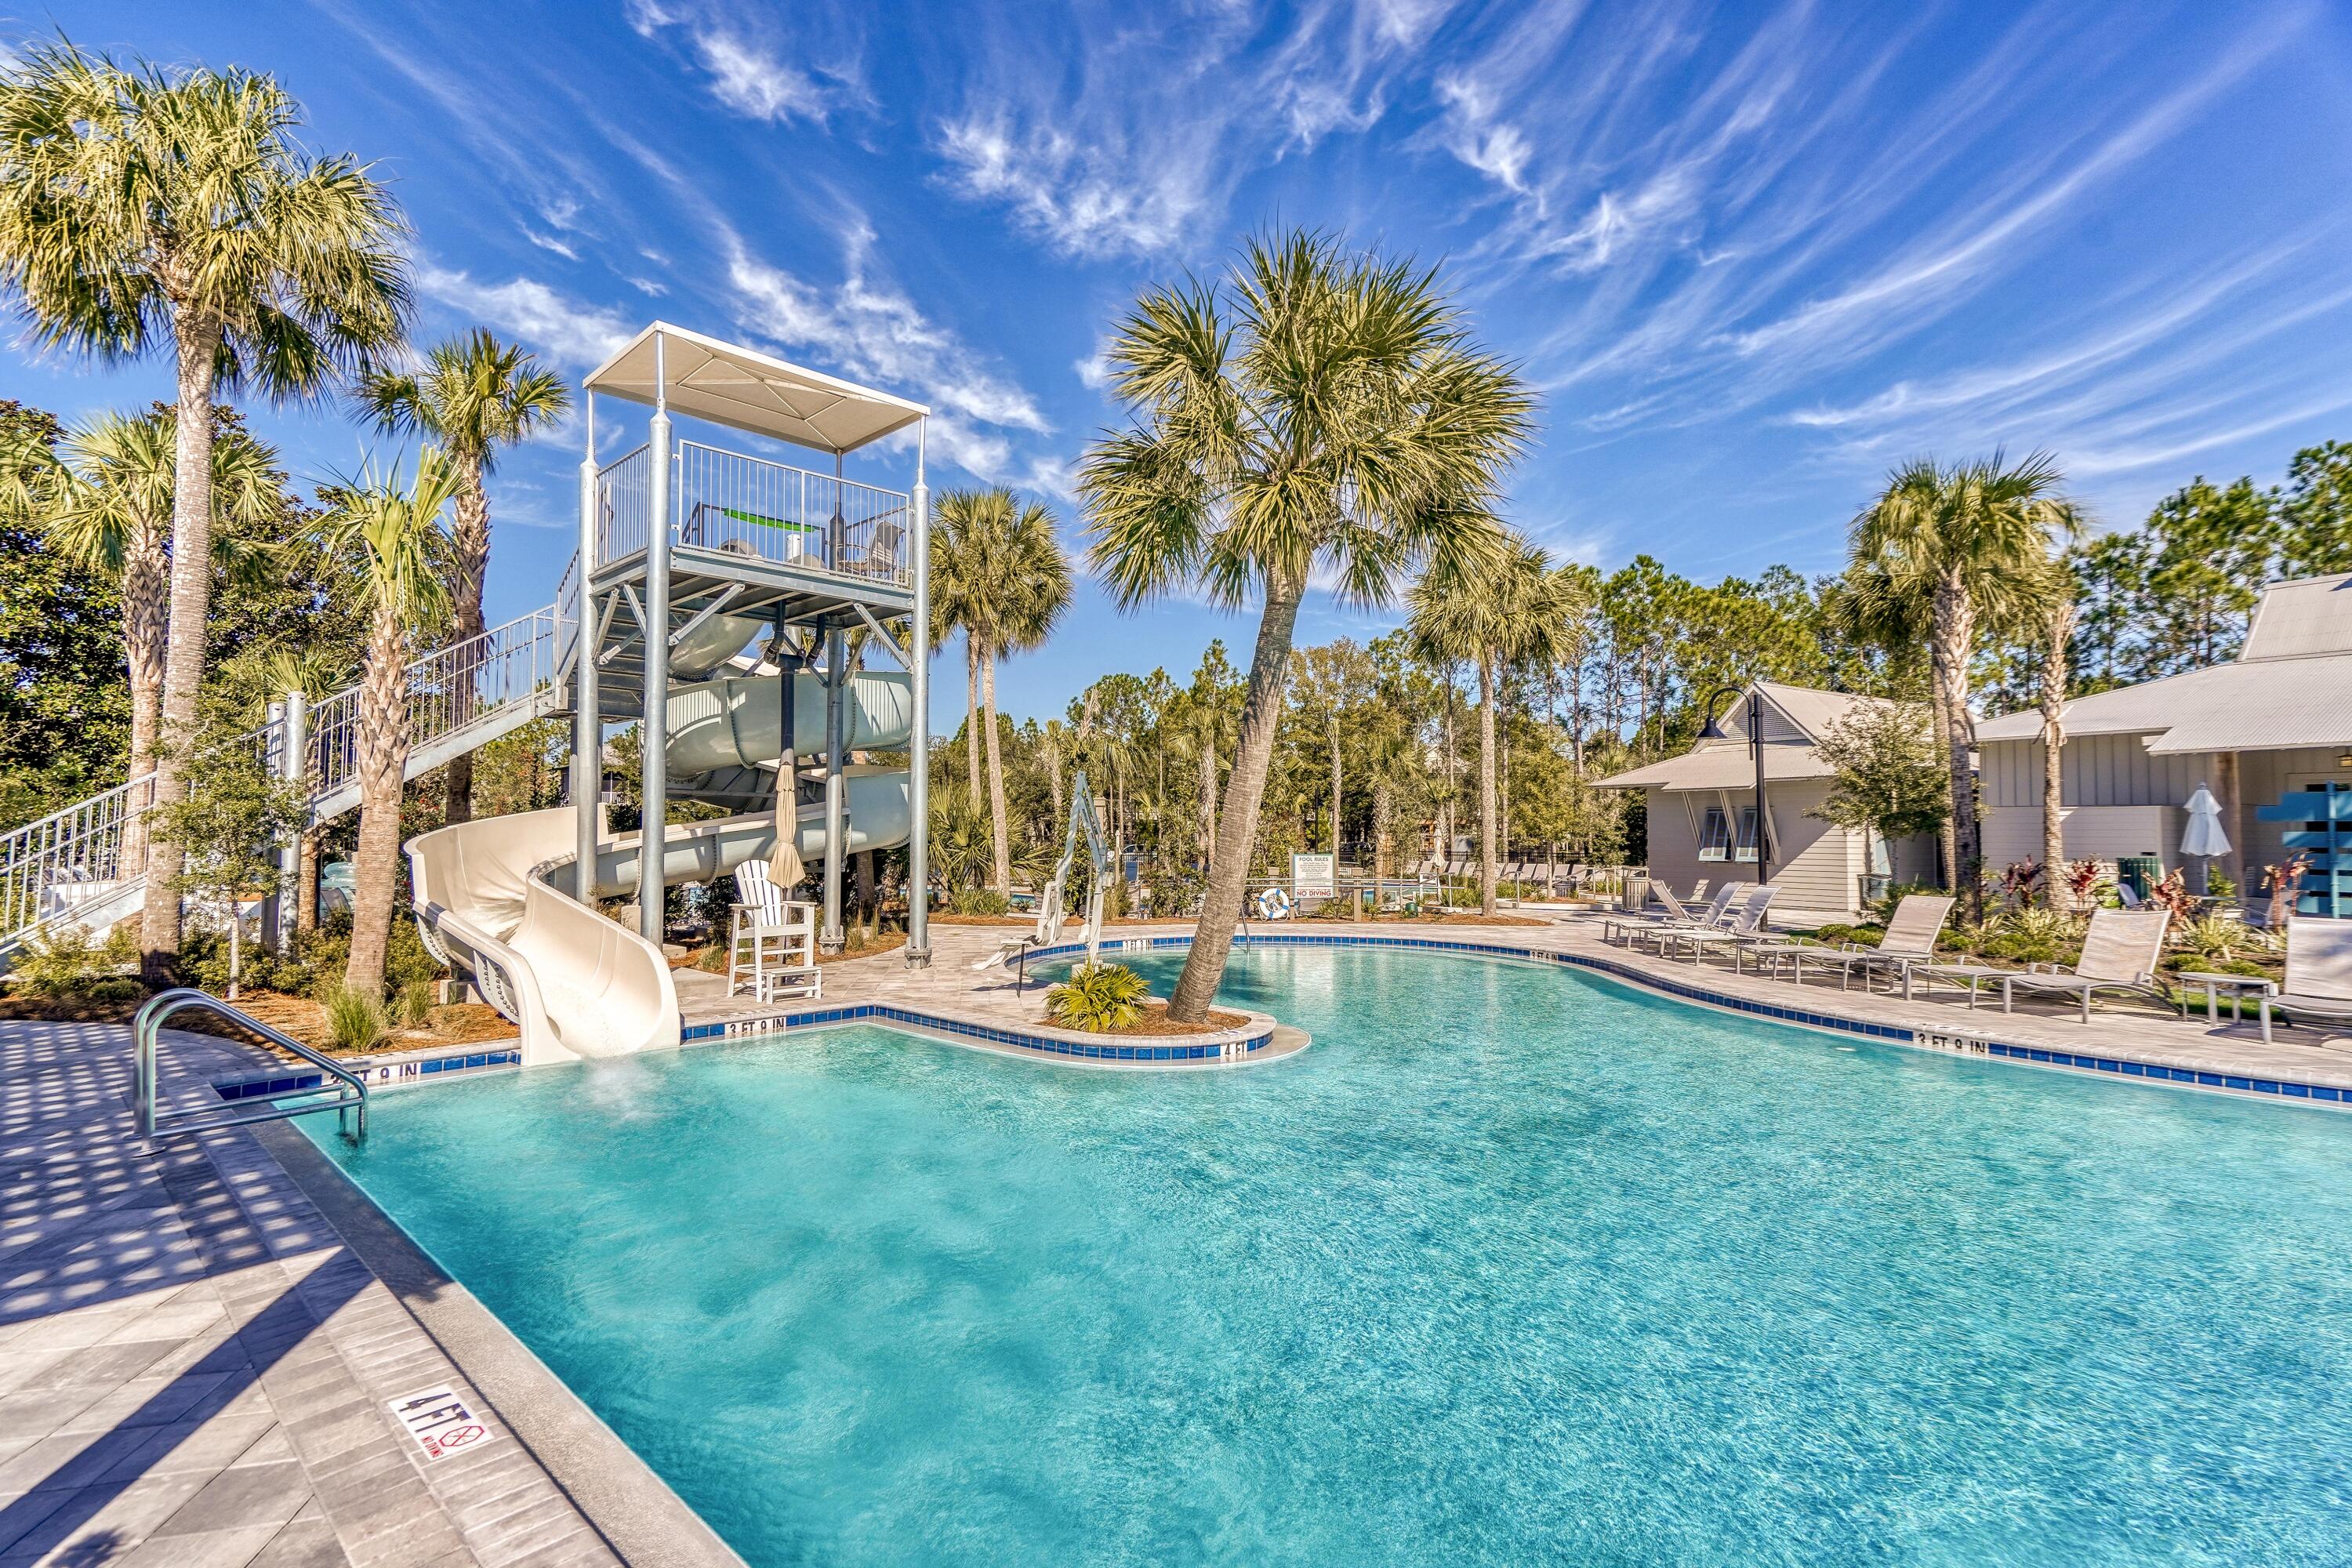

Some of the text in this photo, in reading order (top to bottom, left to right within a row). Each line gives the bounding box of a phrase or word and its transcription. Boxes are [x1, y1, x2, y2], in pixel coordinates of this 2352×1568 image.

[730, 1023, 736, 1033] 3
[742, 1022, 755, 1032] FT
[772, 1018, 785, 1028] IN
[1225, 1040, 1246, 1054] 4 FT
[1918, 1033, 1926, 1044] 3
[1932, 1035, 1948, 1047] FT
[1970, 1040, 1985, 1052] IN
[350, 1069, 371, 1081] T
[399, 1062, 417, 1076] IN
[398, 1392, 472, 1433] 4 FT
